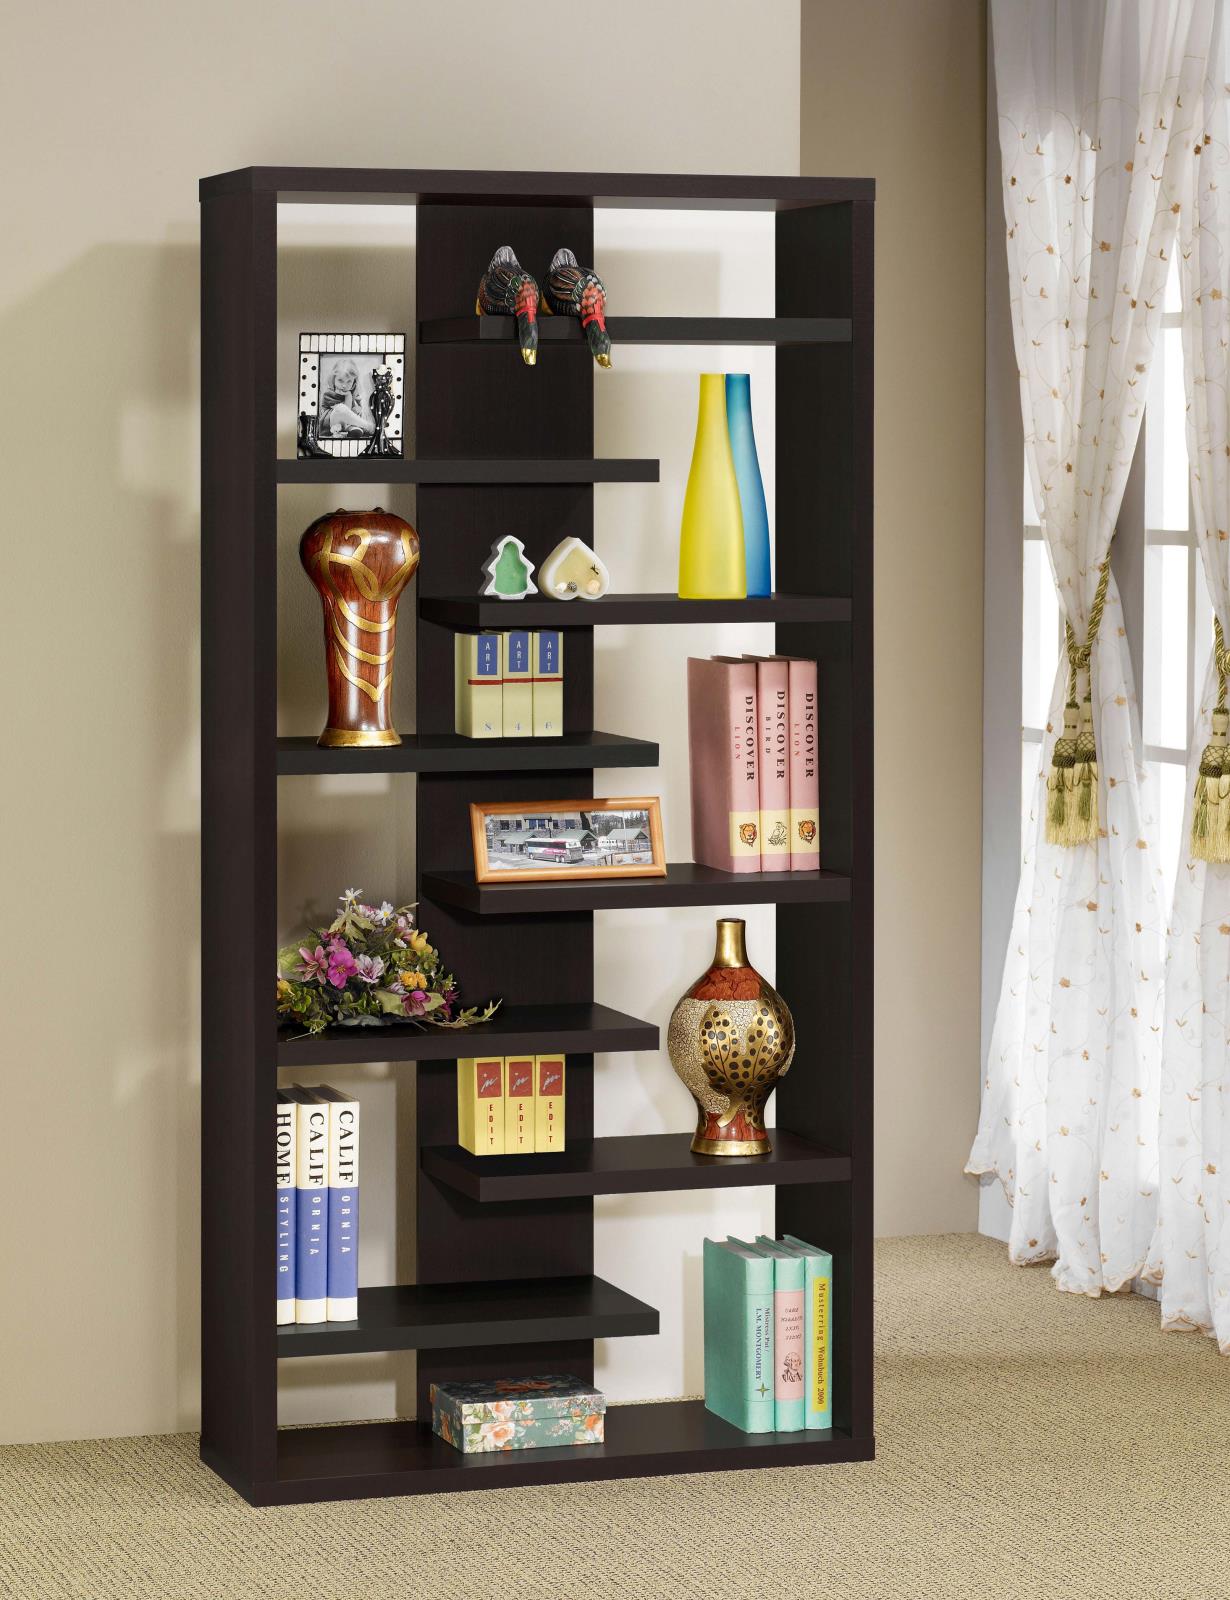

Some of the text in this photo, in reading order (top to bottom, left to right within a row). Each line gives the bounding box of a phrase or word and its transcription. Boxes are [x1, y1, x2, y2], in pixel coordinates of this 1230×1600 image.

[745, 695, 755, 781] DISCOVER
[776, 690, 786, 779] DISCOVER
[805, 692, 814, 778] DISCOVER
[277, 1112, 291, 1272] HOME STYLING
[309, 1111, 325, 1255] CALIF ORNIA
[338, 1110, 354, 1253] CALIF ORNIA
[817, 1283, 826, 1341] Musterring
[817, 1346, 825, 1384] Wohnbuch
